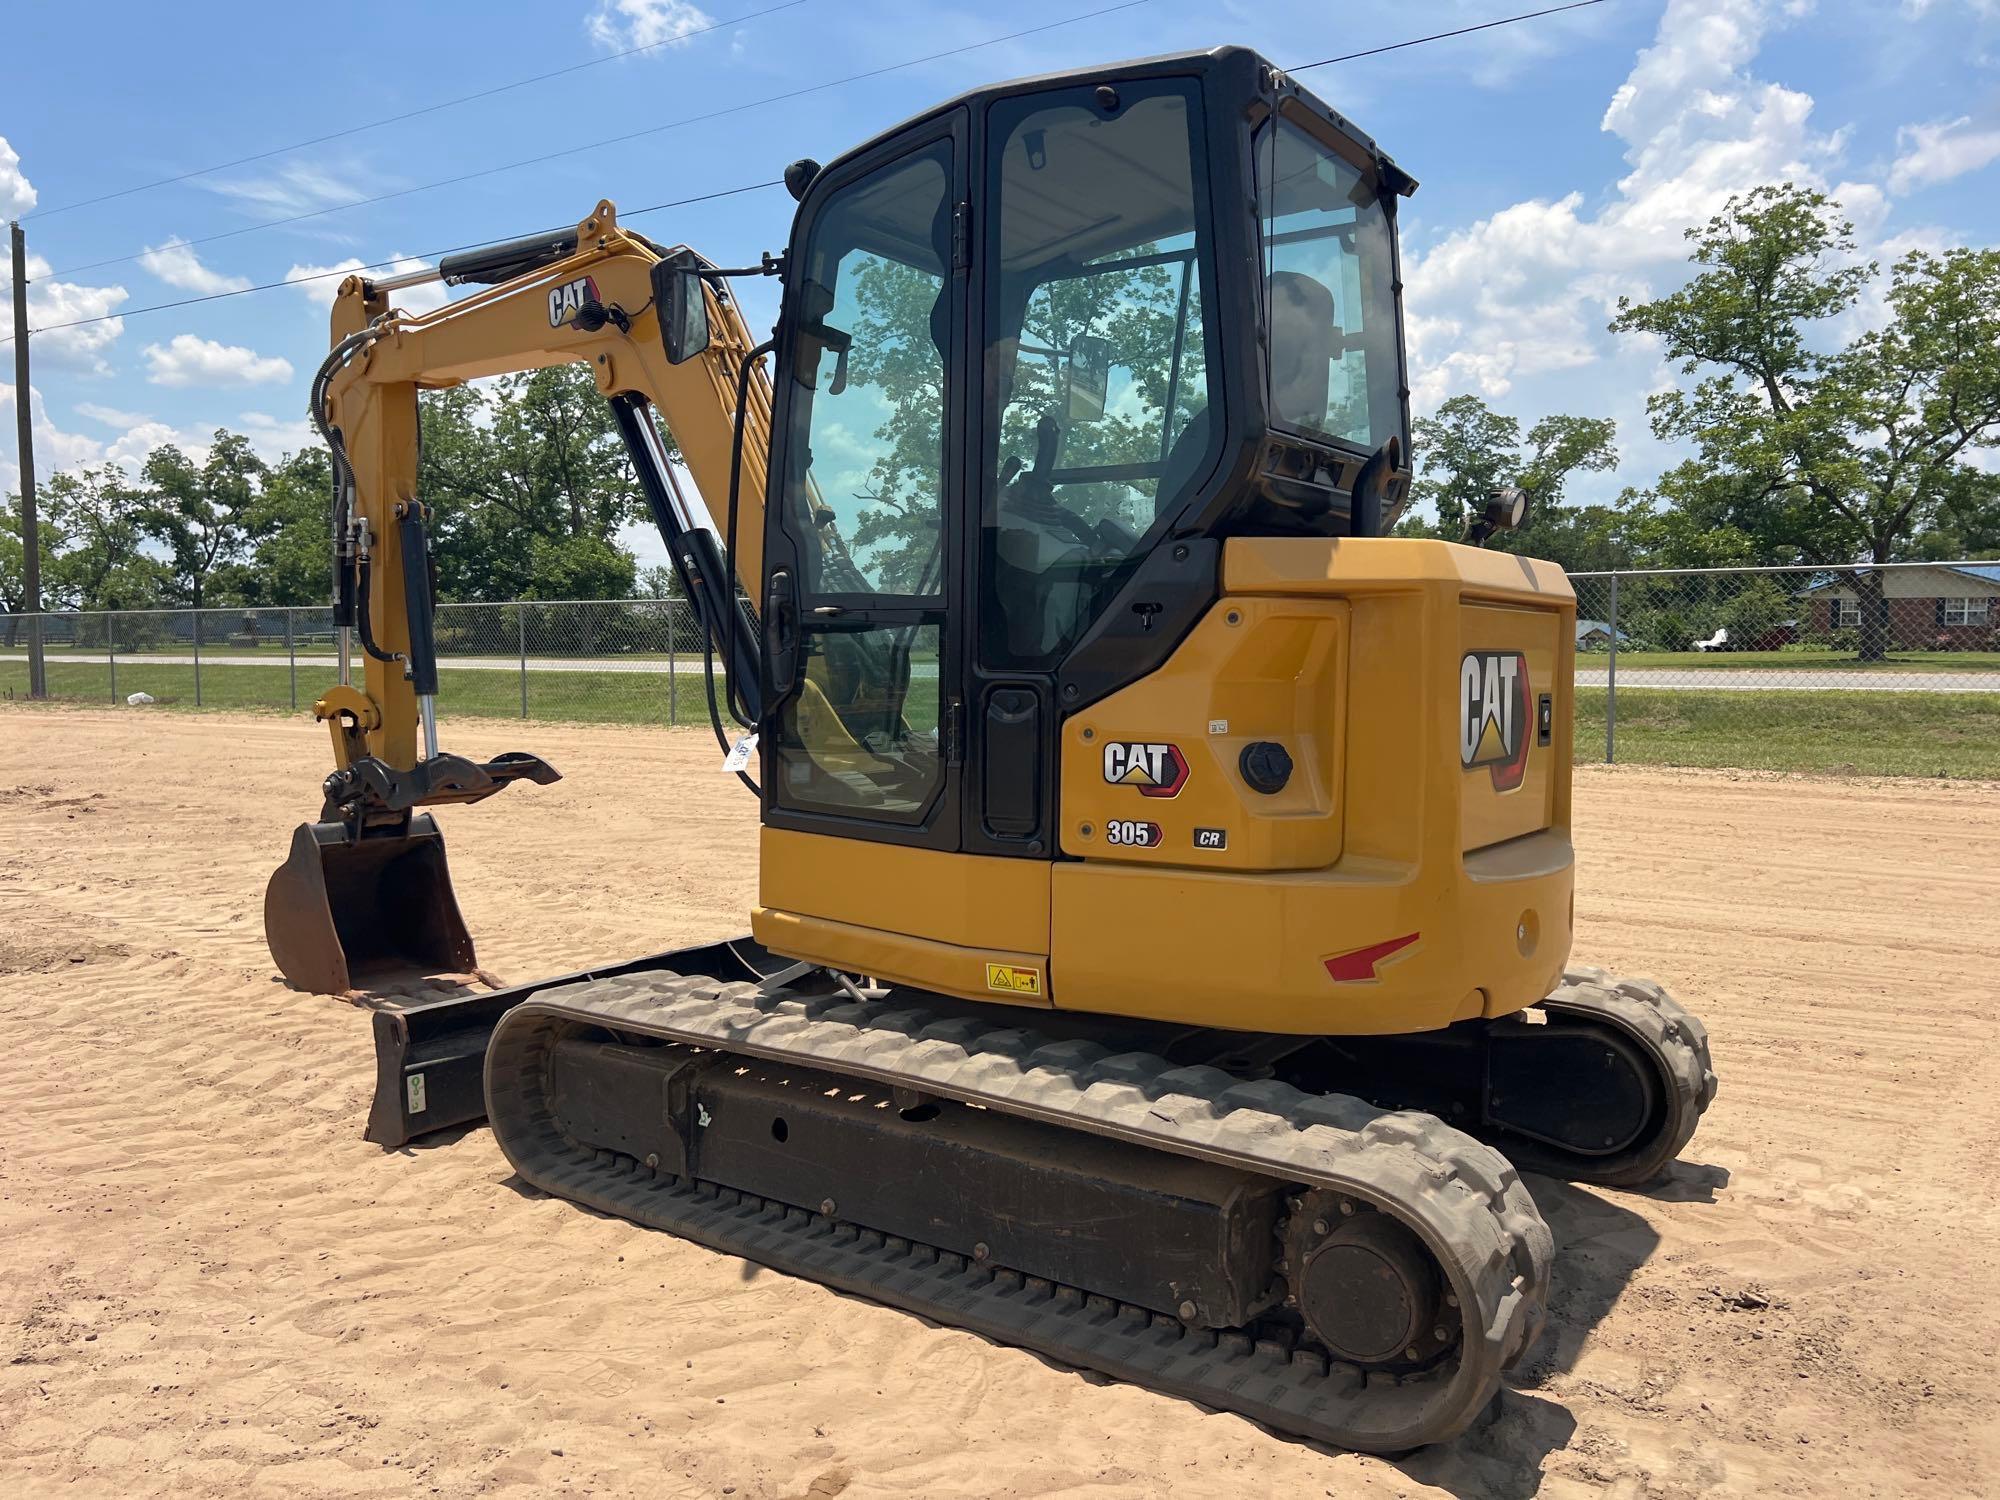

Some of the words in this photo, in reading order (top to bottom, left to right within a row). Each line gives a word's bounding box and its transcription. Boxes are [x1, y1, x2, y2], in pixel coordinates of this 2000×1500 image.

[1460, 655, 1518, 764] CAT
[1104, 742, 1168, 785] CAT
[1107, 820, 1149, 846] 305
[1199, 831, 1220, 846] CR
